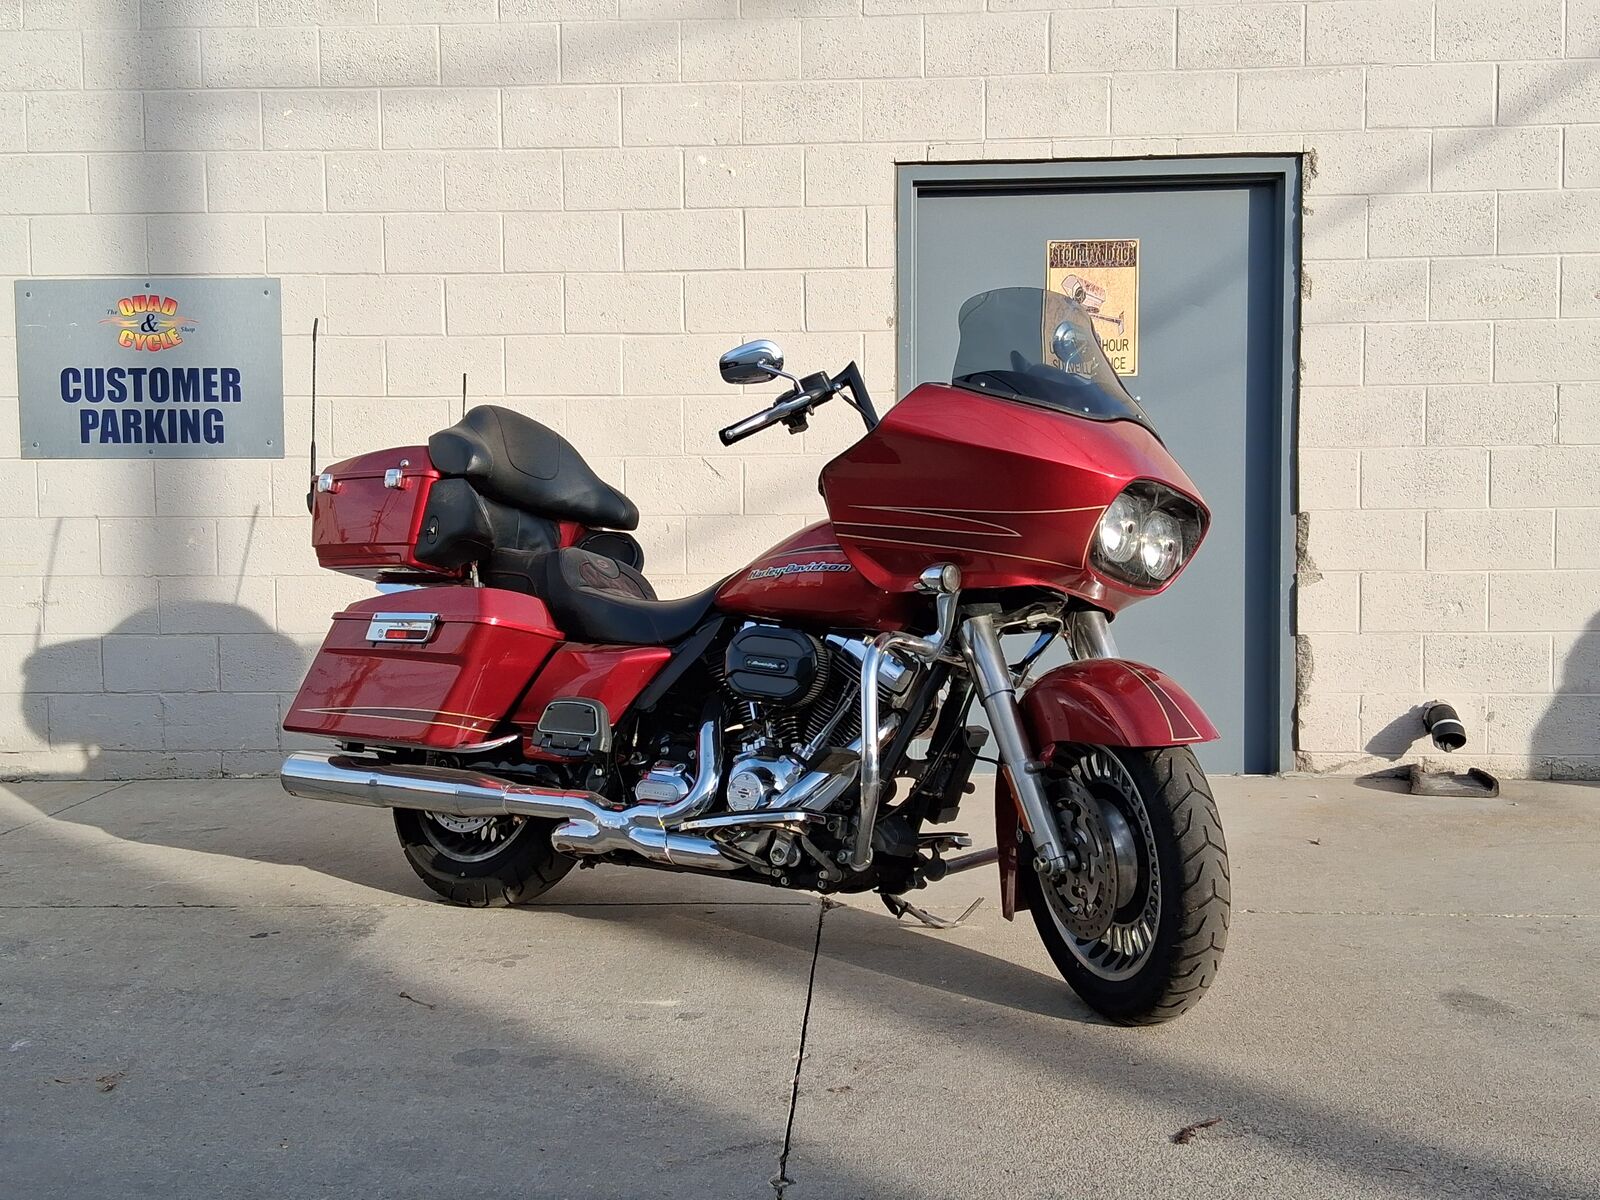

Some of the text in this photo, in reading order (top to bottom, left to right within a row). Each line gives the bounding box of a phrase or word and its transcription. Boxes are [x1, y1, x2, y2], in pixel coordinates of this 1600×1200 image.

[1053, 247, 1135, 261] SECURITY NOTICE
[118, 295, 178, 317] QUAD
[141, 313, 159, 332] &
[118, 327, 183, 352] CYCLE
[1102, 338, 1129, 352] HOUR
[60, 367, 242, 403] CUSTOMER
[79, 408, 225, 444] PARKING
